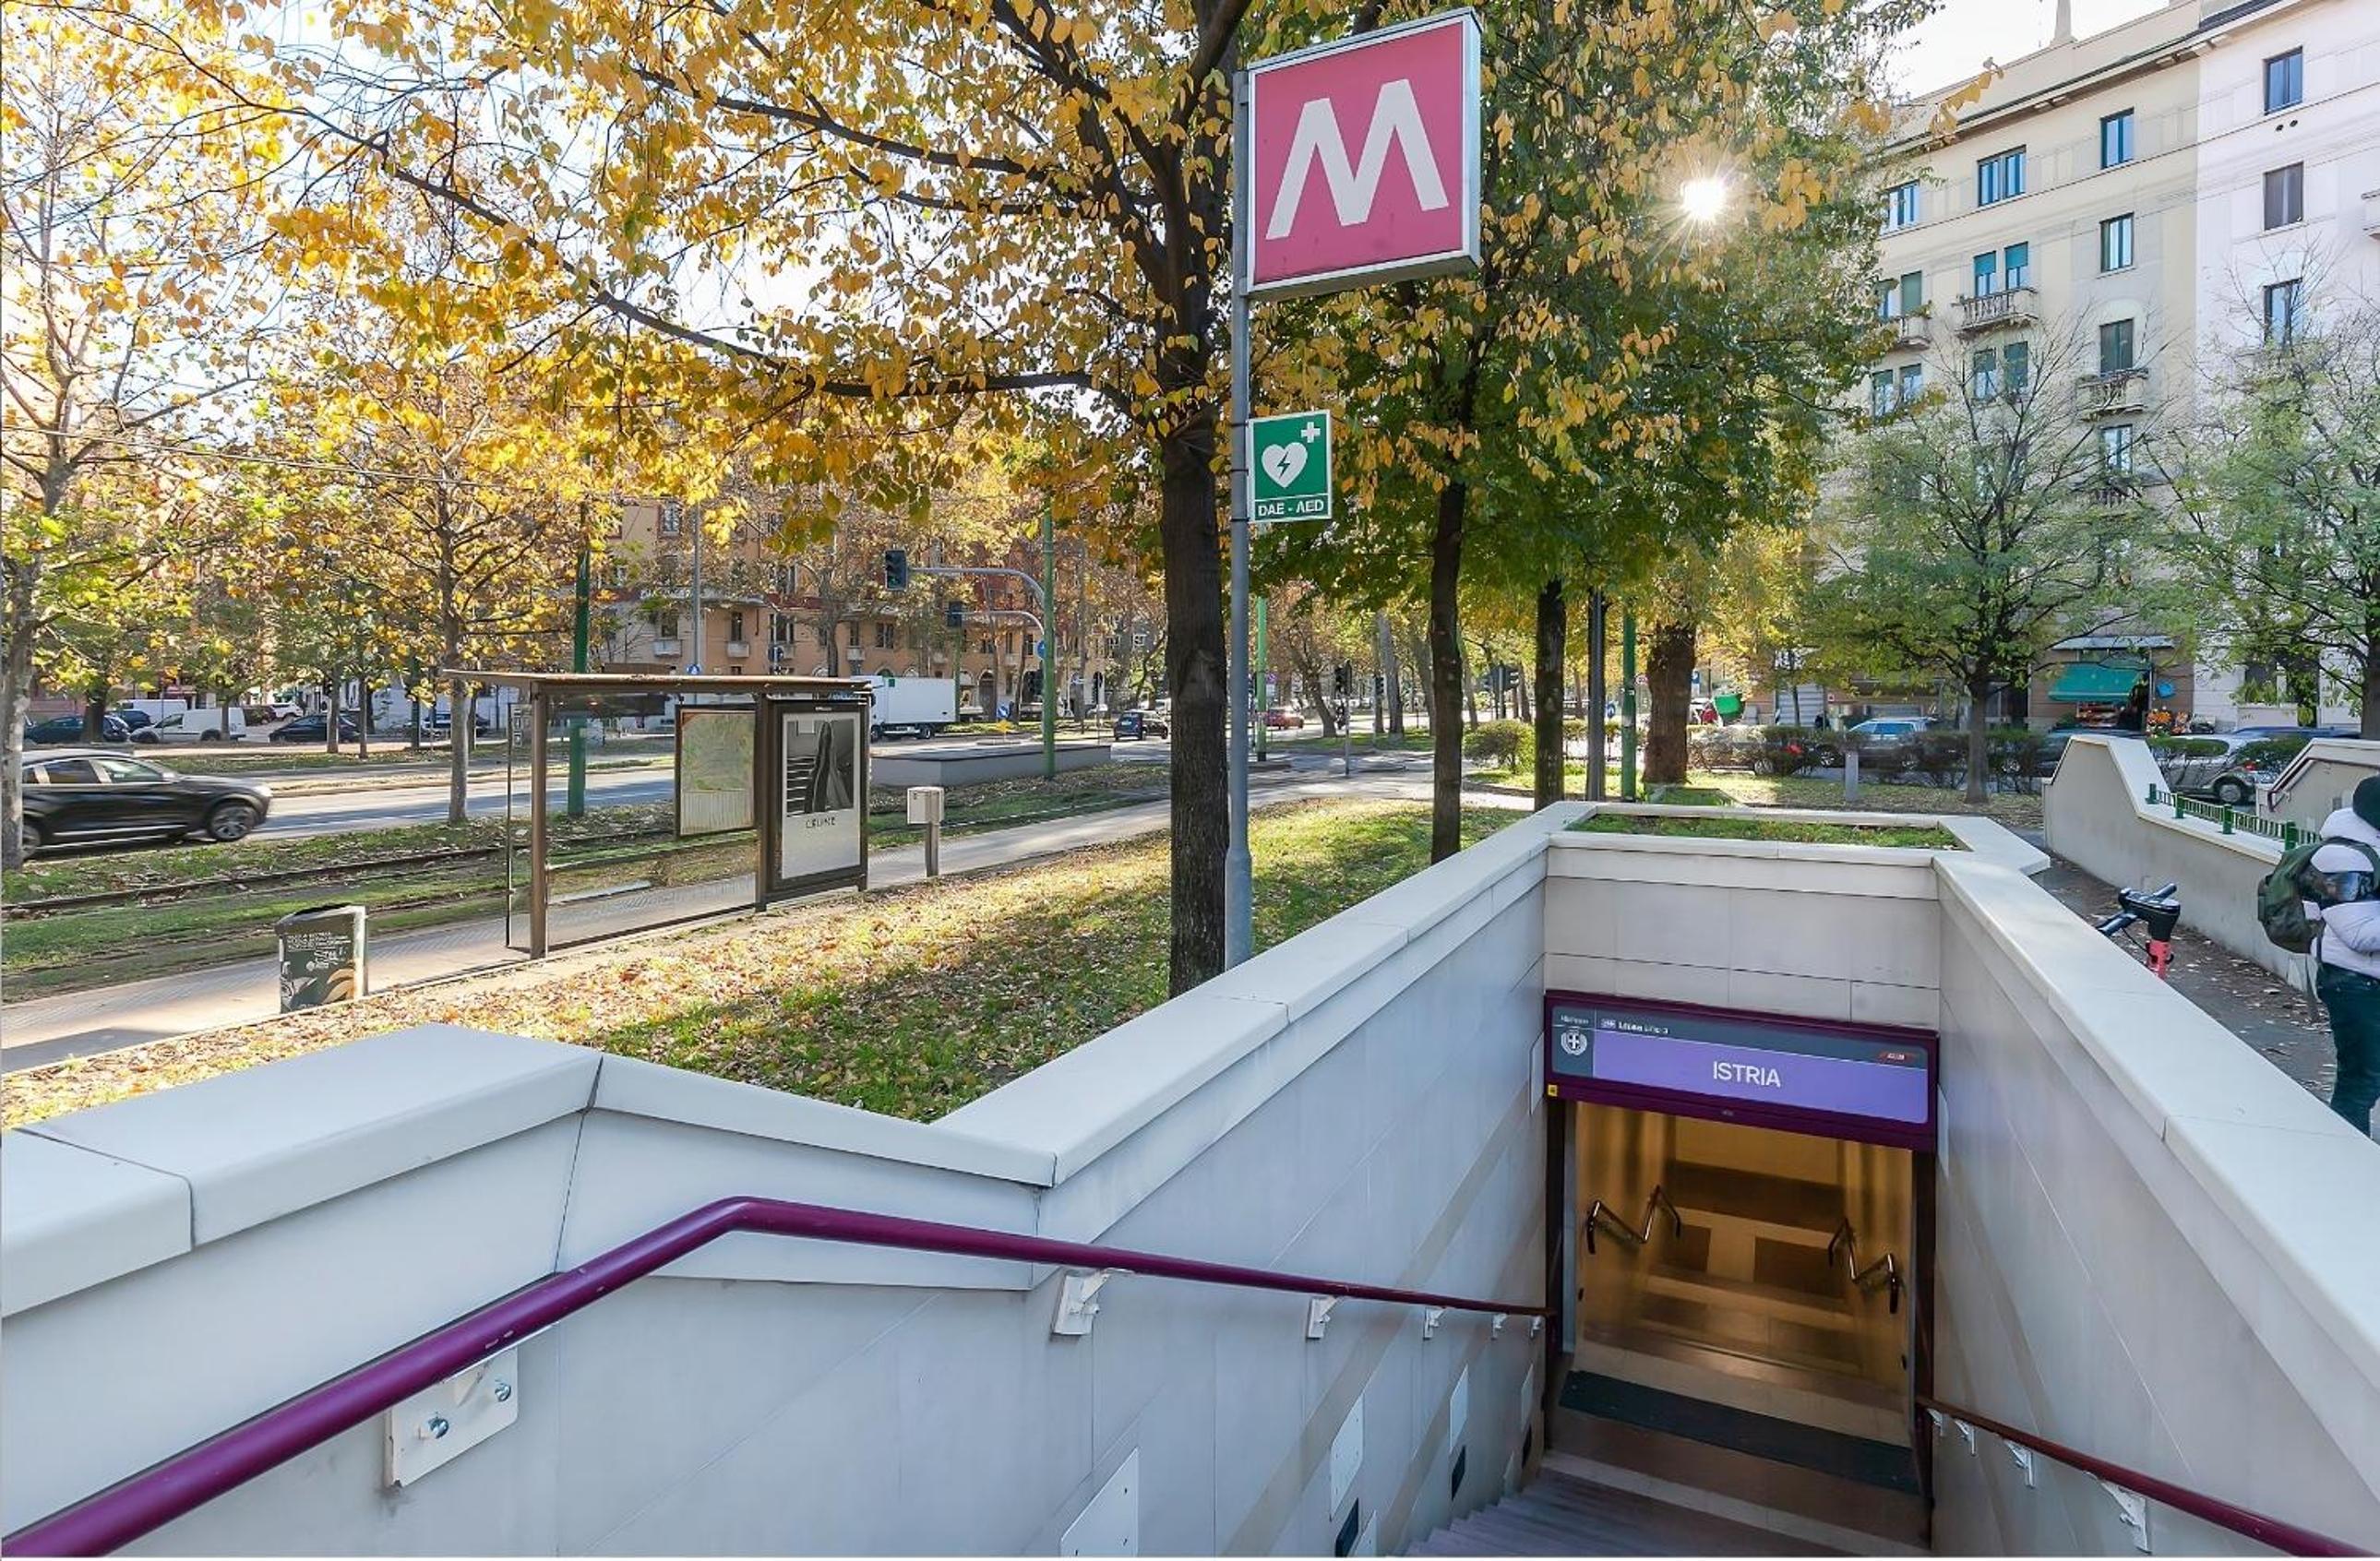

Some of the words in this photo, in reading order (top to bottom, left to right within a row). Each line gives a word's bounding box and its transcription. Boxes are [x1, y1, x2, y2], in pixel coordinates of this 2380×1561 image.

[1265, 78, 1450, 241] M
[1258, 502, 1285, 517] DAE
[1296, 499, 1324, 513] AED
[1713, 1060, 1781, 1088] ISTRIA
